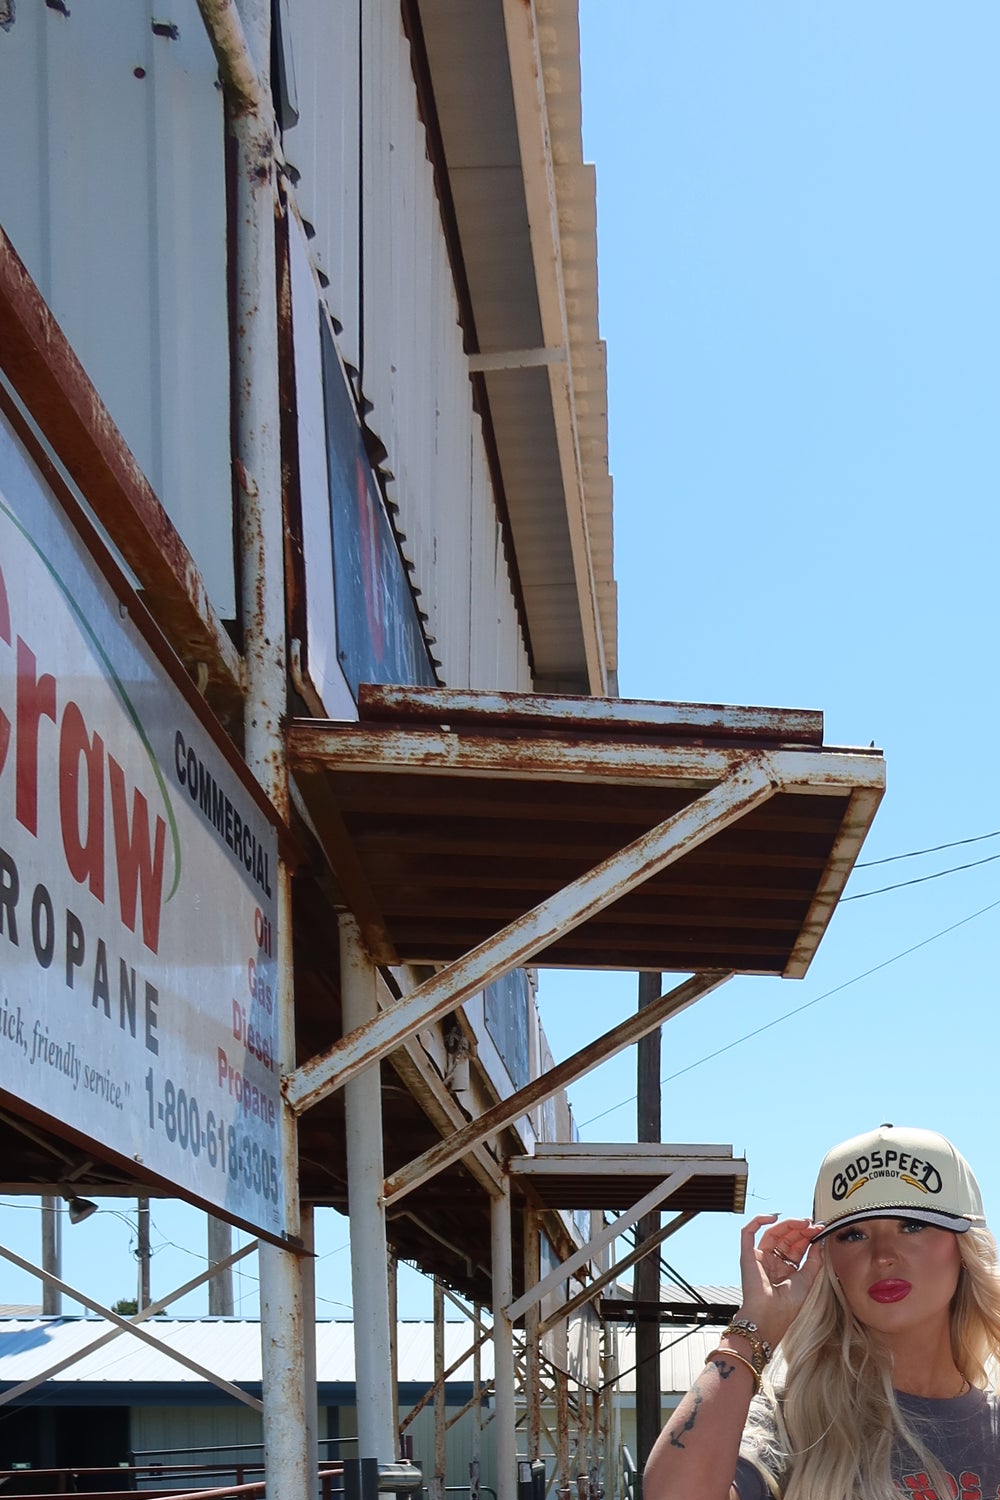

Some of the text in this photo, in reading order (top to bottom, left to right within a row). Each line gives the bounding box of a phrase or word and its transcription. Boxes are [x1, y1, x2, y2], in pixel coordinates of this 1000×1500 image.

[0, 566, 166, 955] raw
[174, 730, 273, 900] COMMERCIAL
[0, 846, 159, 1057] ROPANE
[254, 907, 272, 959] Oil
[248, 957, 273, 1016] Gas
[0, 998, 28, 1056] ick,
[30, 1019, 81, 1091] friendly
[232, 998, 274, 1073] Diesel
[217, 1046, 276, 1130] Propane
[145, 1066, 279, 1205] 1-800-618-3305
[832, 1150, 943, 1201] GODSPEED
[868, 1170, 900, 1180] COWBOY
